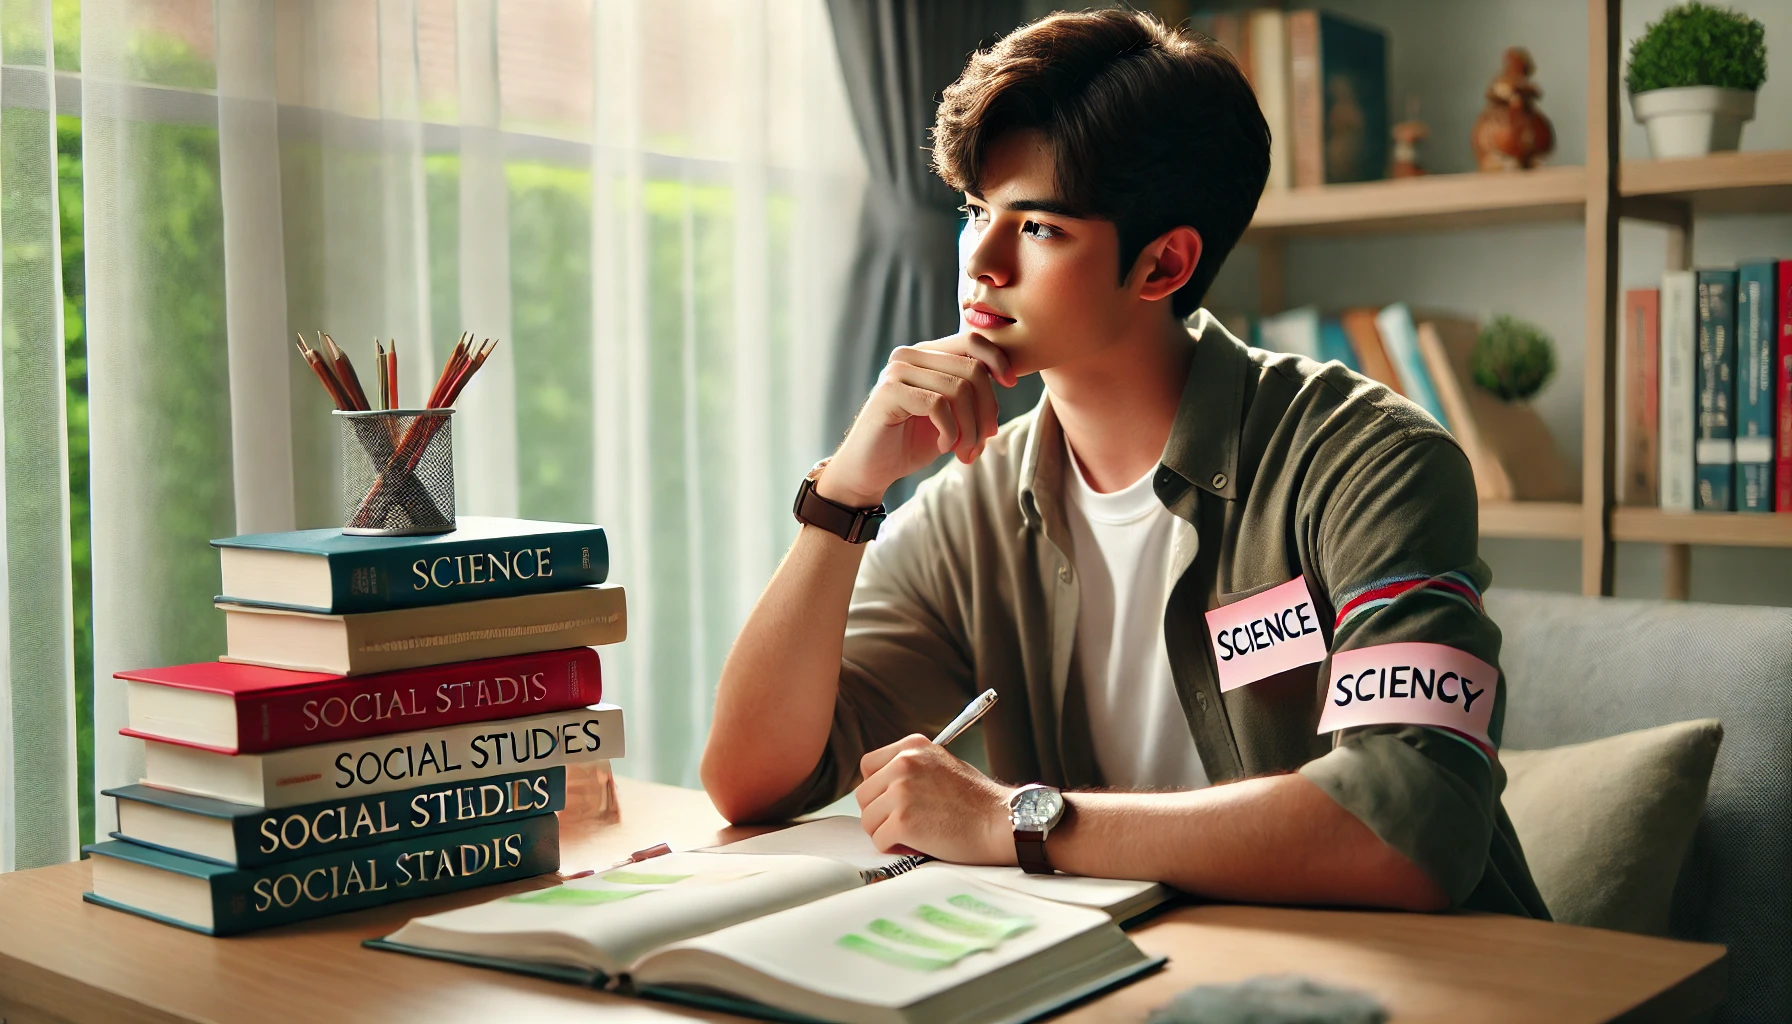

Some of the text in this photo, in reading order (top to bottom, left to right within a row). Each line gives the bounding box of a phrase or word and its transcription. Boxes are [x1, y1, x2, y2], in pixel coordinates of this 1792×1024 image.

[412, 546, 553, 591] SCIENCE
[1216, 601, 1318, 661] SCIENCE
[302, 688, 427, 731] SOCIAL
[436, 672, 547, 713] STADIS
[1334, 665, 1485, 713] SCIENCY
[334, 719, 601, 789] SOCIAL STUDIES
[260, 801, 400, 854] SOCIAL
[253, 859, 388, 912] SOCIAL
